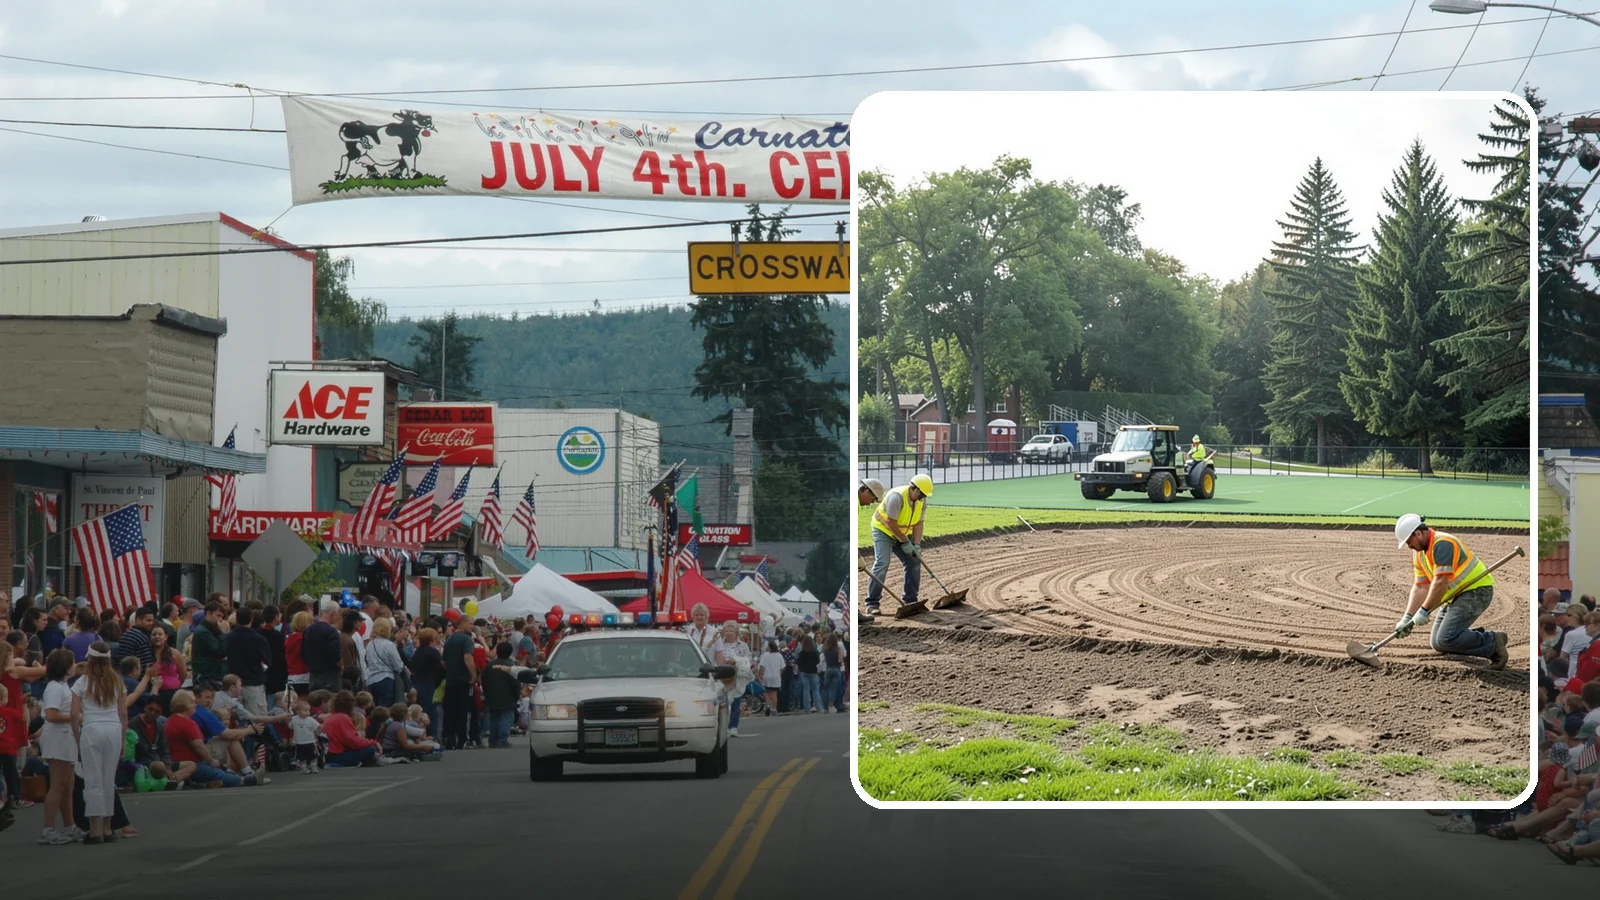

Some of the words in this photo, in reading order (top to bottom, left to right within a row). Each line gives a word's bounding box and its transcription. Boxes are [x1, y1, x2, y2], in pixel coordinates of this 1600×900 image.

[695, 121, 850, 149] Carnat
[481, 141, 604, 192] JULY
[632, 150, 746, 197] 4th.
[697, 254, 850, 280] CROSSWA
[283, 380, 373, 420] ACE
[406, 409, 452, 421] CEDAR
[283, 421, 370, 437] Hardware
[416, 428, 477, 447] Coca-Cola
[353, 467, 385, 480] Simpl
[83, 485, 94, 494] St.
[96, 485, 124, 495] Vincent
[126, 486, 135, 495] de
[138, 486, 155, 495] Paul
[688, 526, 741, 535] CRNATION
[699, 535, 730, 543] GLASS
